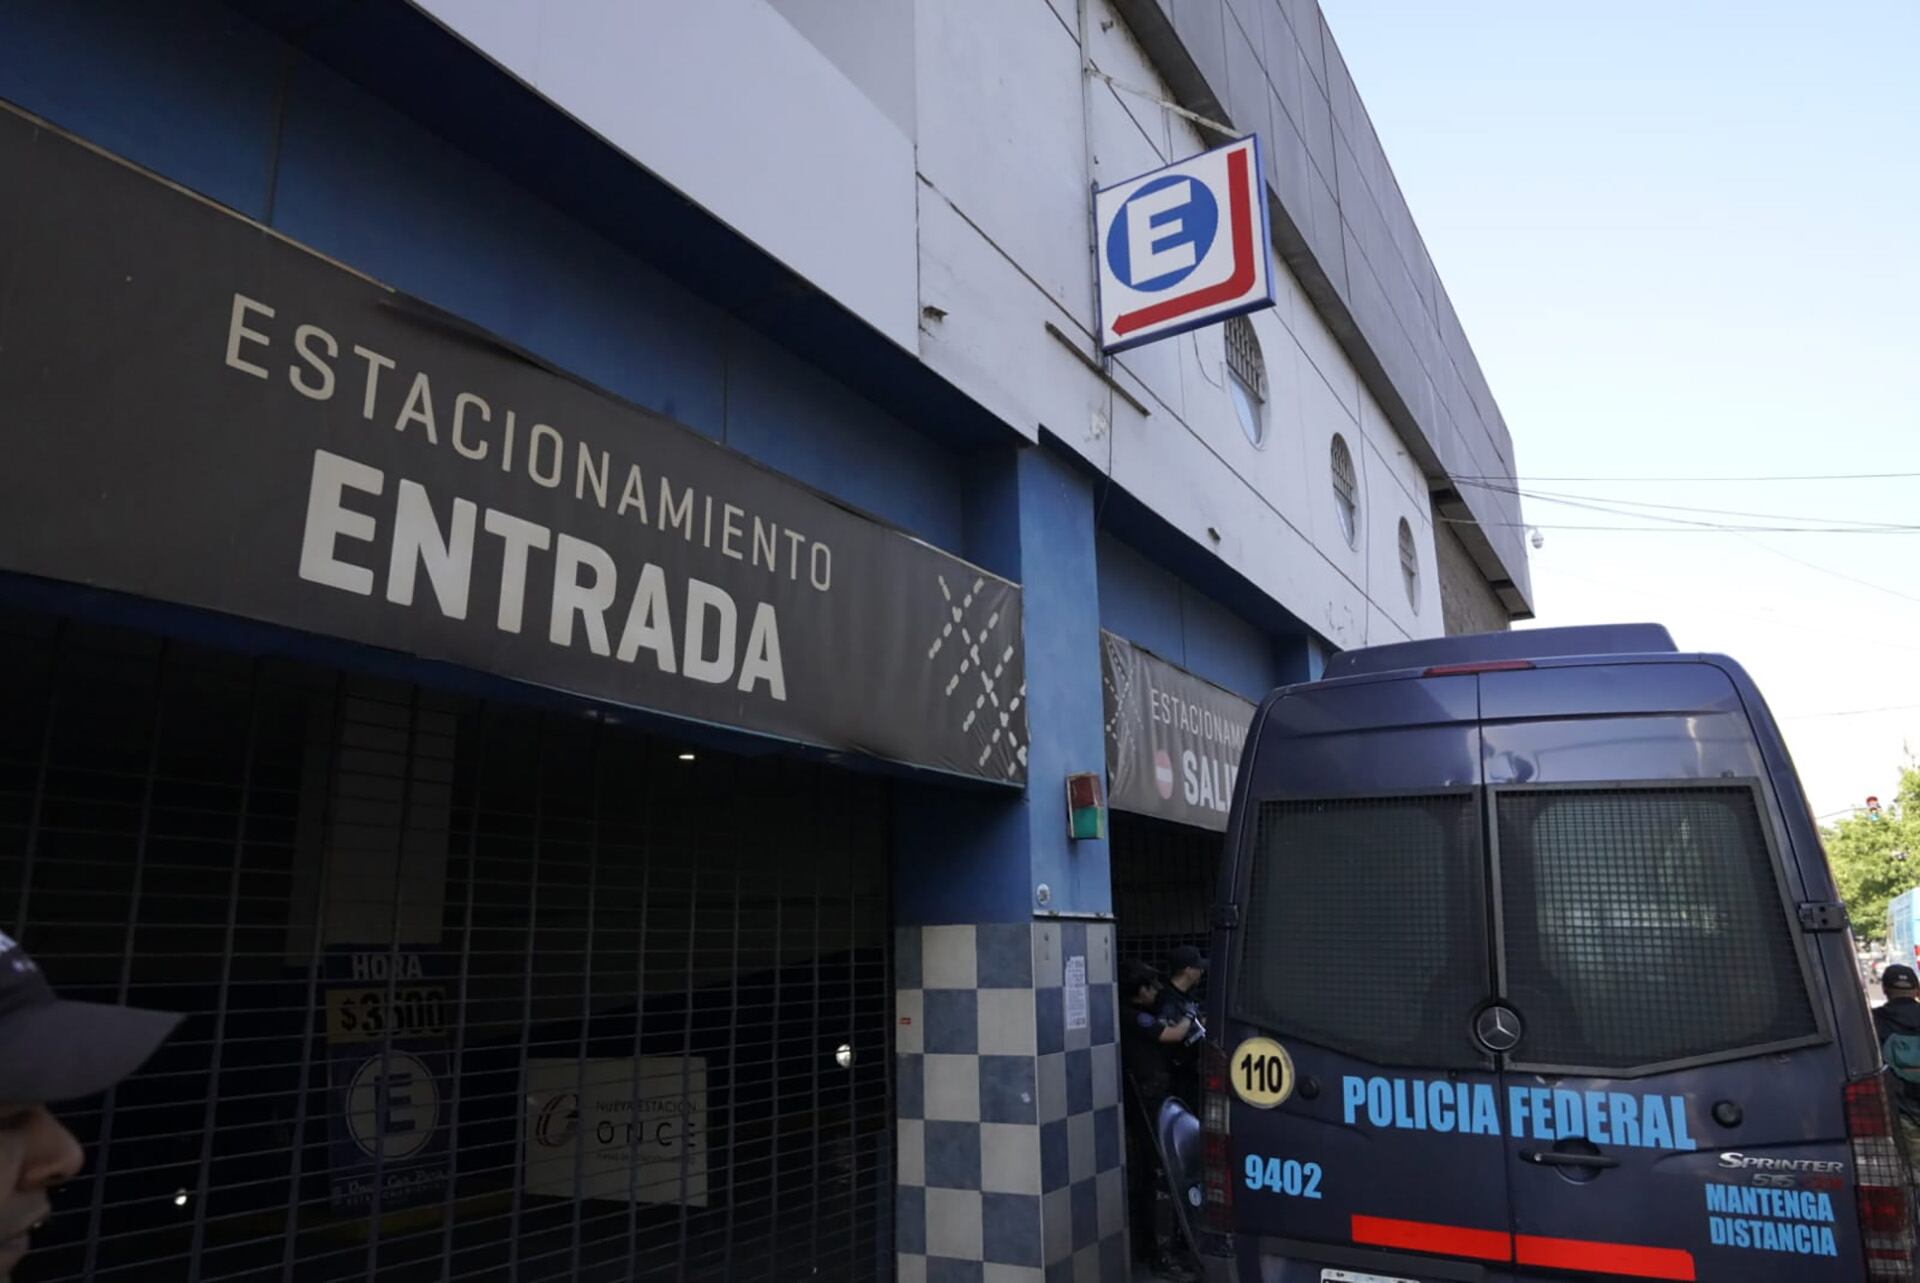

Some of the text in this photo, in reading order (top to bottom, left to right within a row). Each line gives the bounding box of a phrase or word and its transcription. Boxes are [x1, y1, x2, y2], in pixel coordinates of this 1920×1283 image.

[1126, 179, 1196, 286] E
[226, 293, 832, 591] ESTACIONAMIENTO
[299, 449, 786, 700] ENTRADA
[1151, 689, 1248, 746] ESTACIONAMI
[352, 954, 423, 980] HORA
[1241, 1054, 1283, 1094] 110
[374, 1072, 416, 1134] E
[1343, 1075, 1696, 1150] POLICIA FEDERAL
[597, 1120, 695, 1146] ONCE
[1245, 1154, 1322, 1199] 9402
[1705, 1183, 1835, 1222] MANTENGA
[1709, 1216, 1838, 1256] DISTANCIA
